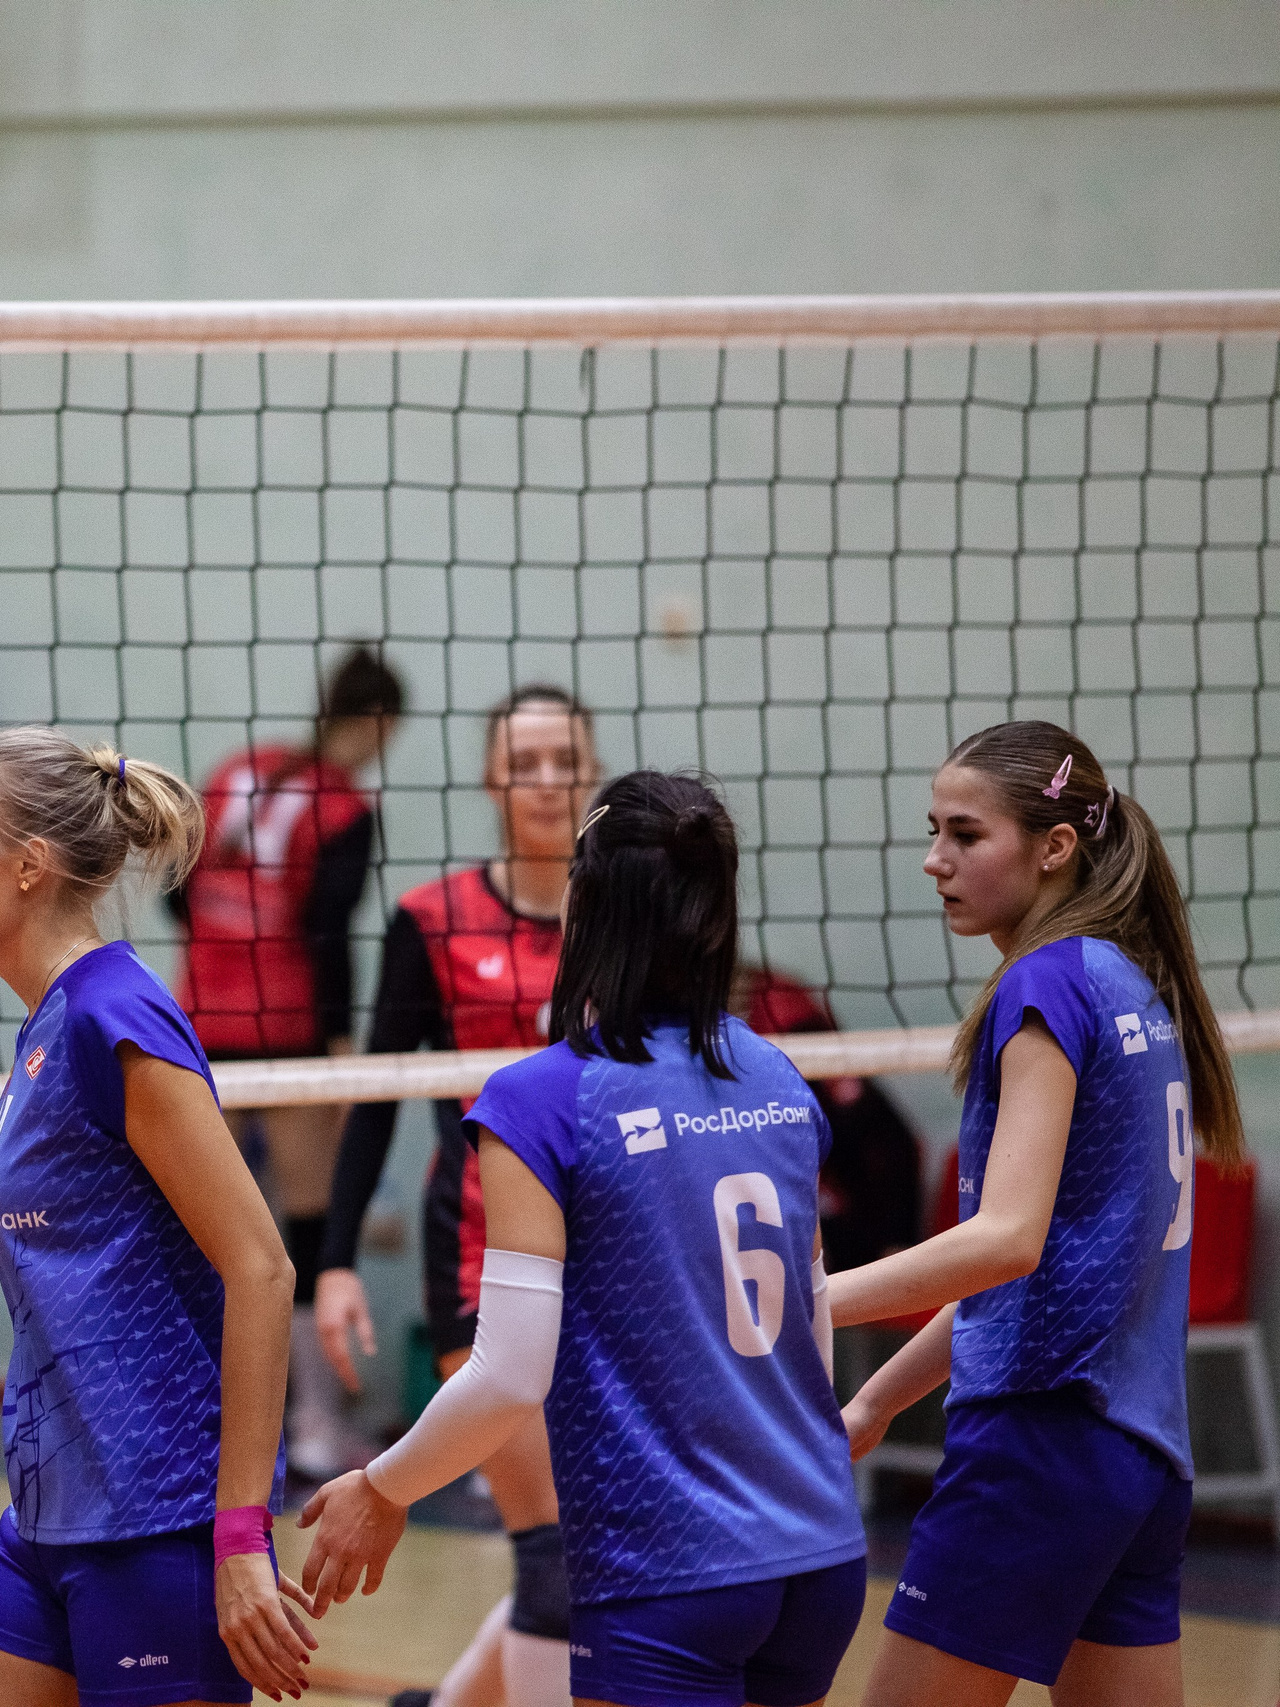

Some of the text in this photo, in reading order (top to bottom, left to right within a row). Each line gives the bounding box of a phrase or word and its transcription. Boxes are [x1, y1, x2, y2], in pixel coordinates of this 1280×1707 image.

[673, 1102, 810, 1136] РосДорБанк
[1162, 1081, 1194, 1251] 9
[713, 1171, 786, 1358] 6
